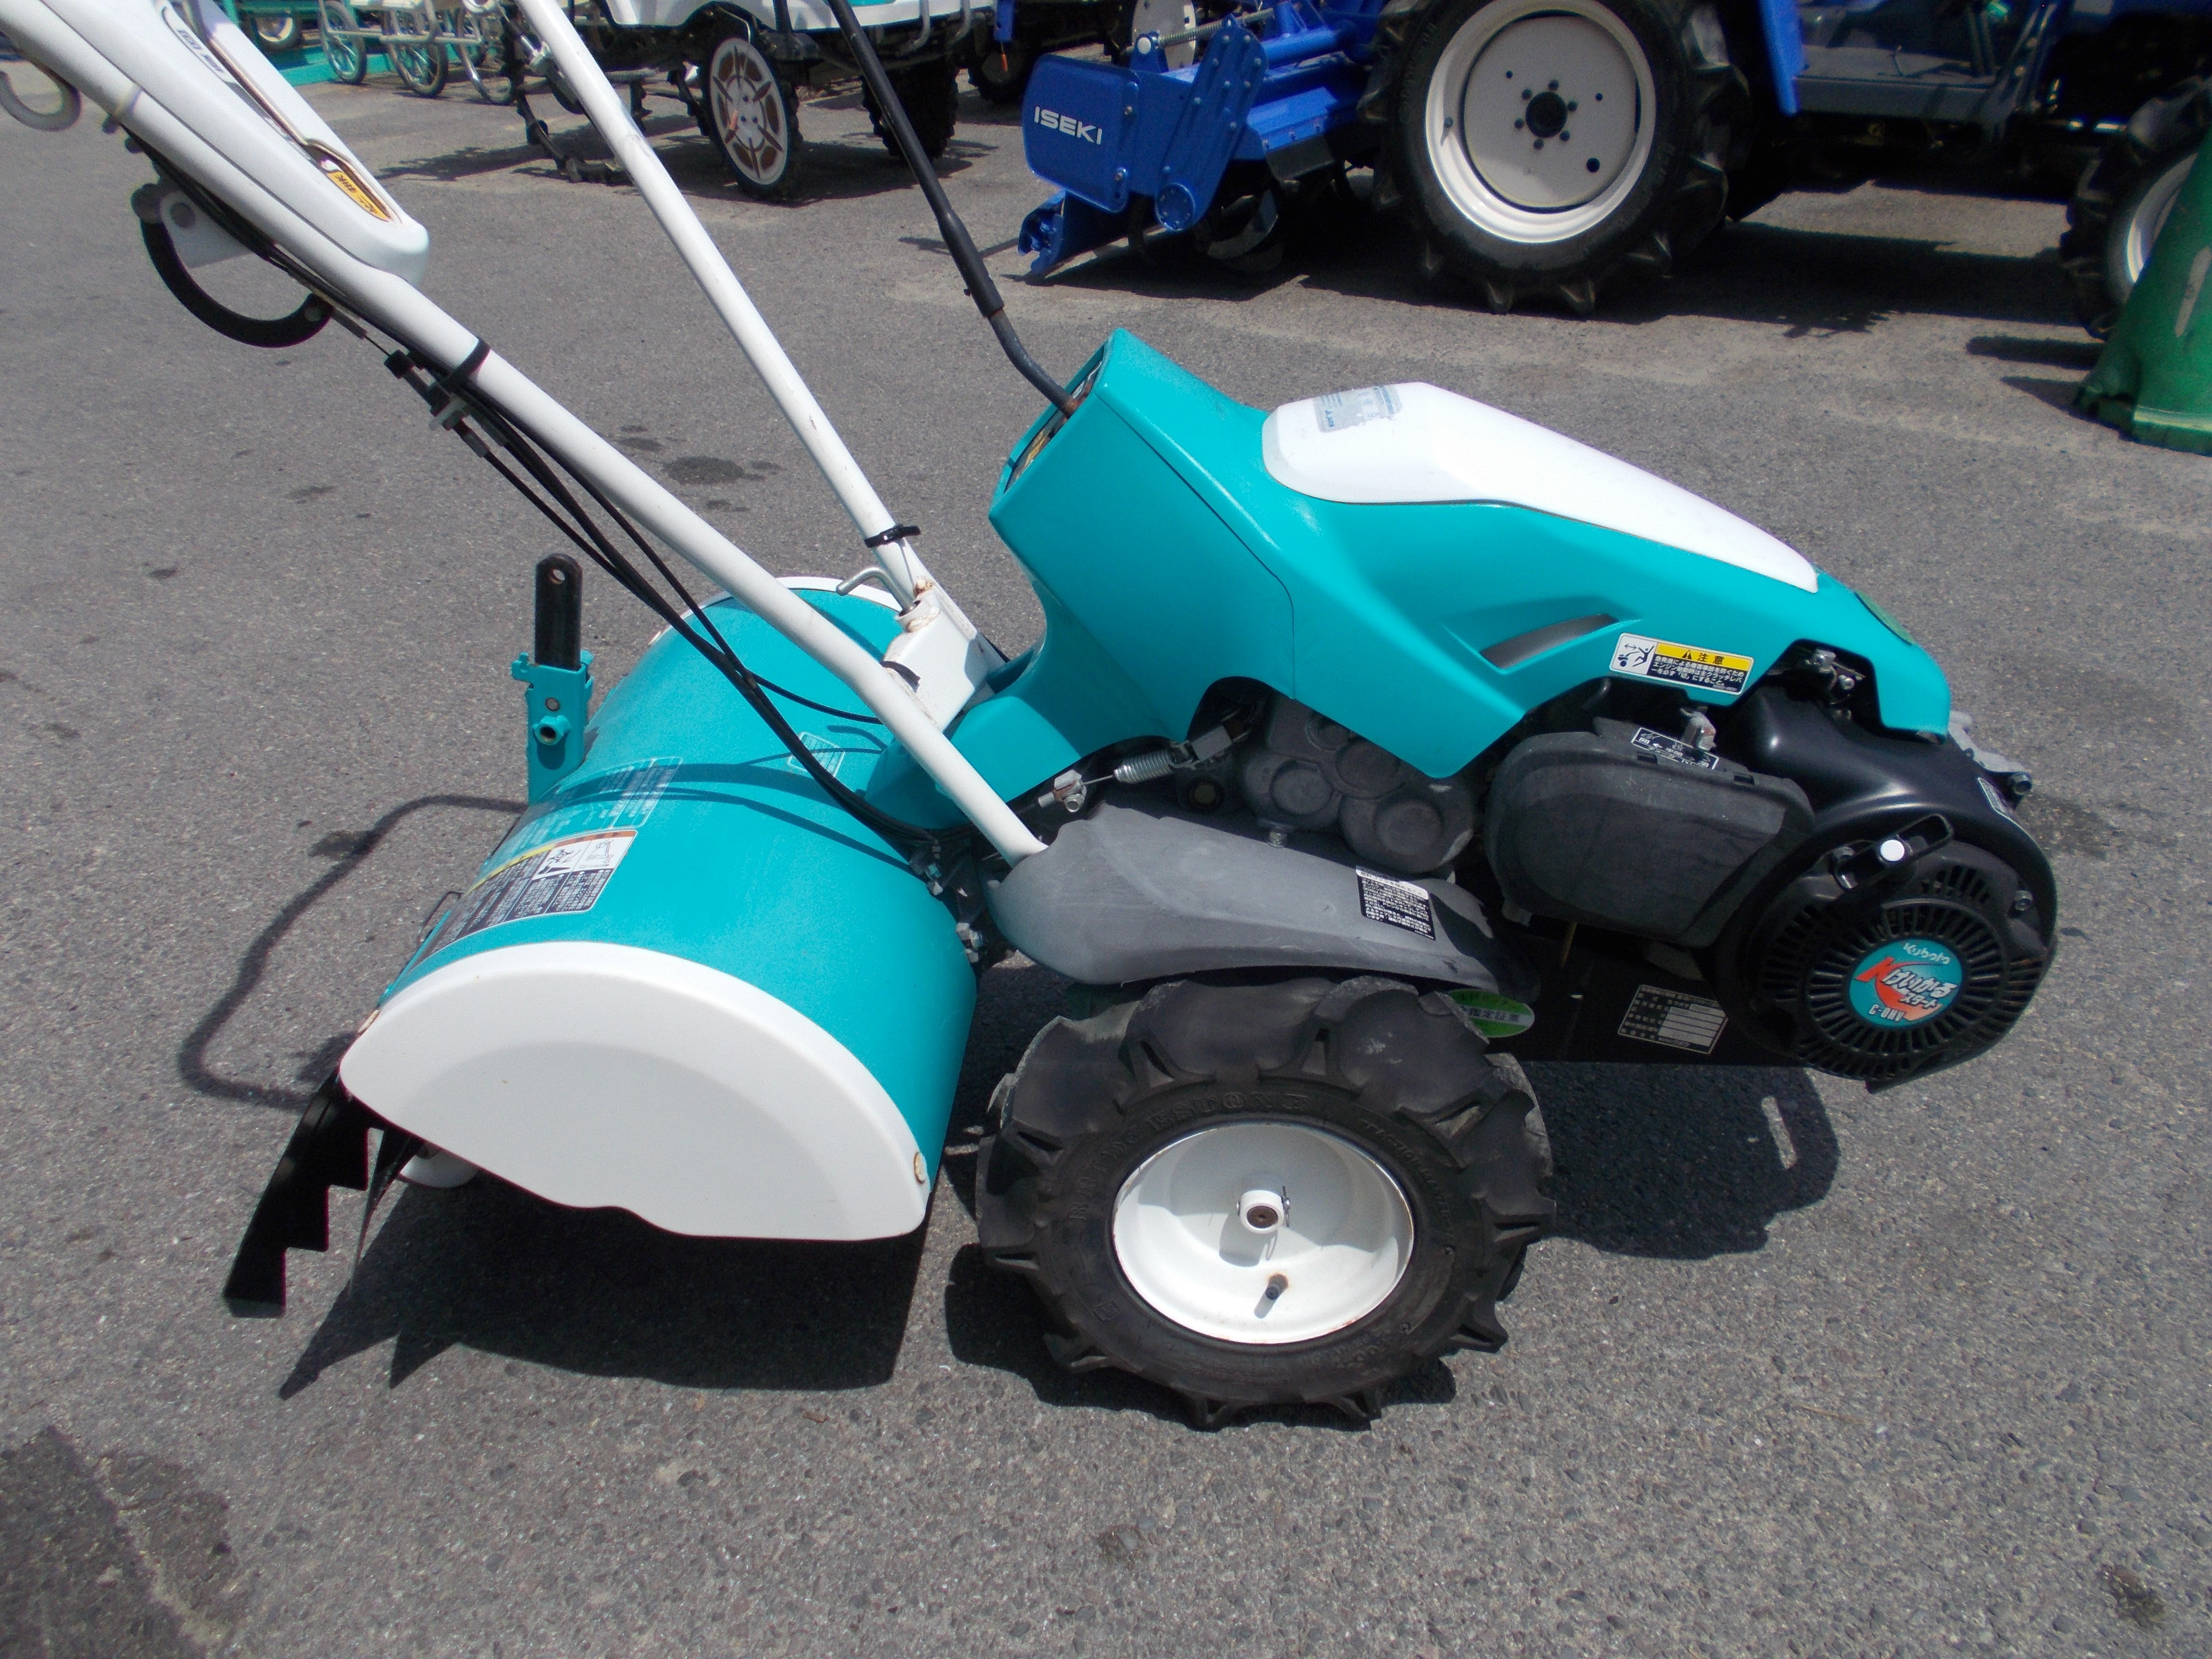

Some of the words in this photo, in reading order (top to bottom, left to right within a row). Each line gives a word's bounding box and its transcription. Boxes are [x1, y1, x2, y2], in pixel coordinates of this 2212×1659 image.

[1034, 106, 1103, 145] ISEKI
[1697, 652, 1725, 665] 注意
[1903, 943, 1951, 965] Kubota
[1069, 1092, 1310, 1222] BRIDGESTONE
